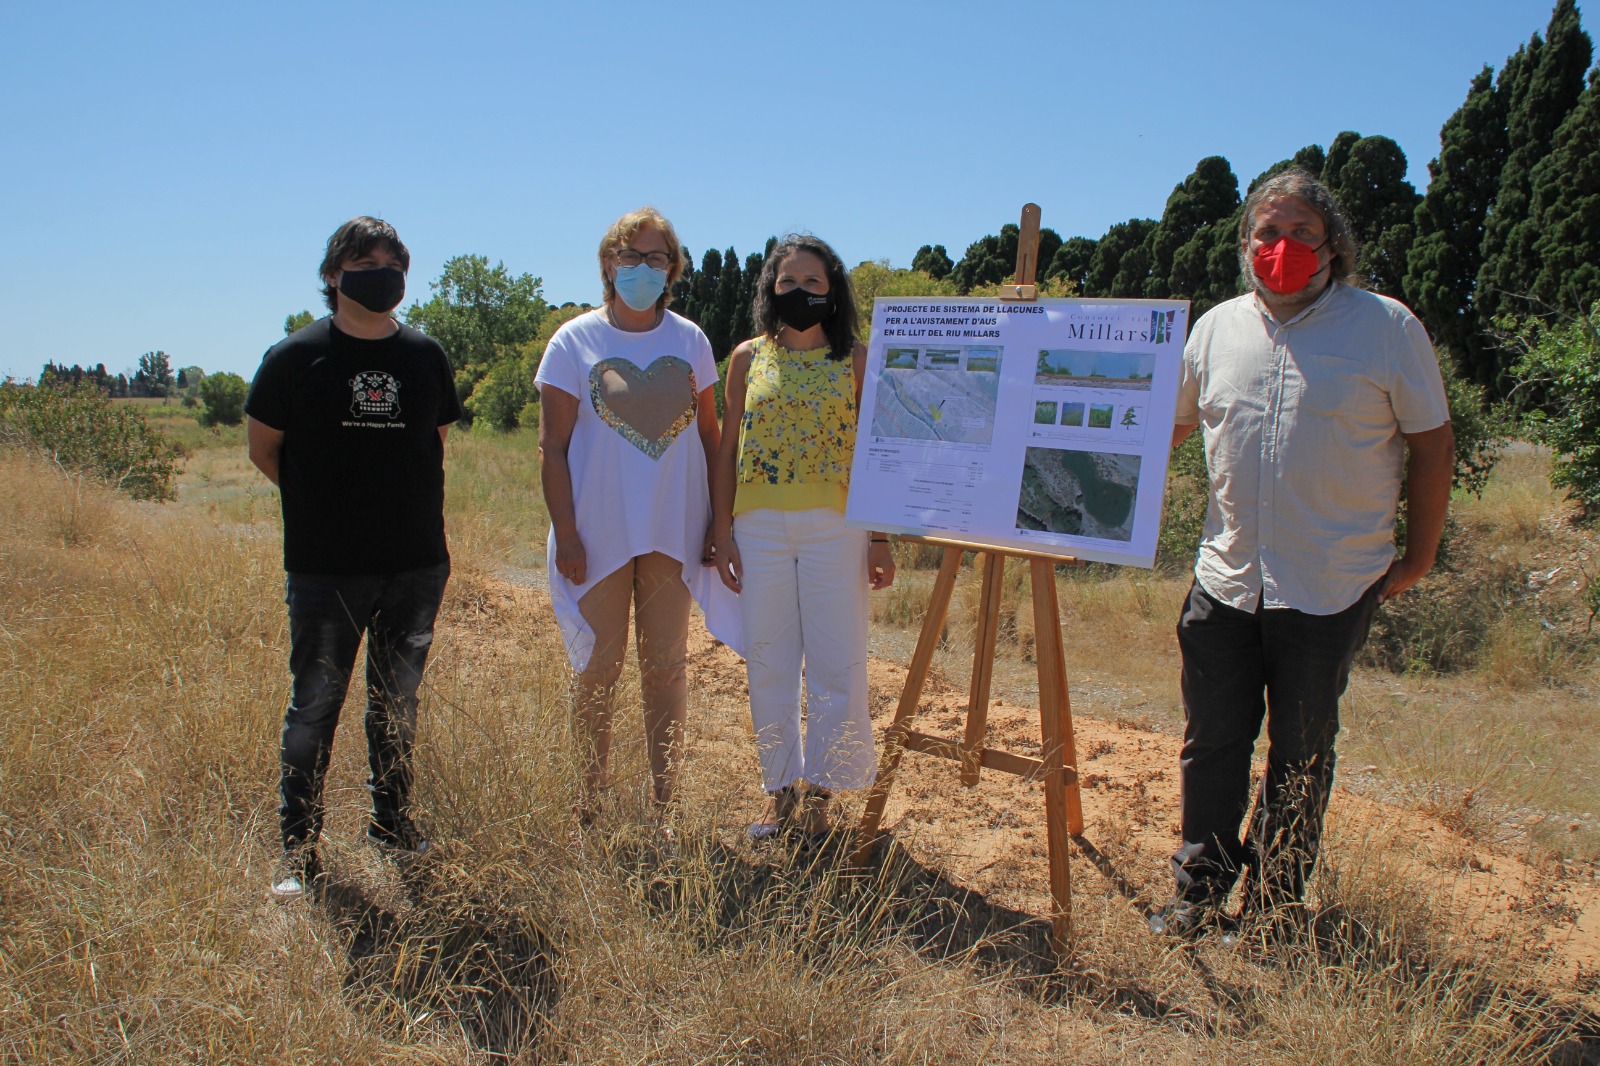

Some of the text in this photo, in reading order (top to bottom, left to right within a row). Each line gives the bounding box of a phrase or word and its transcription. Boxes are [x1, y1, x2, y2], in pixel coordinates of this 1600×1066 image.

[997, 306, 1044, 314] LLACUNES
[963, 330, 1000, 338] MILLARS
[1067, 323, 1148, 342] Millars
